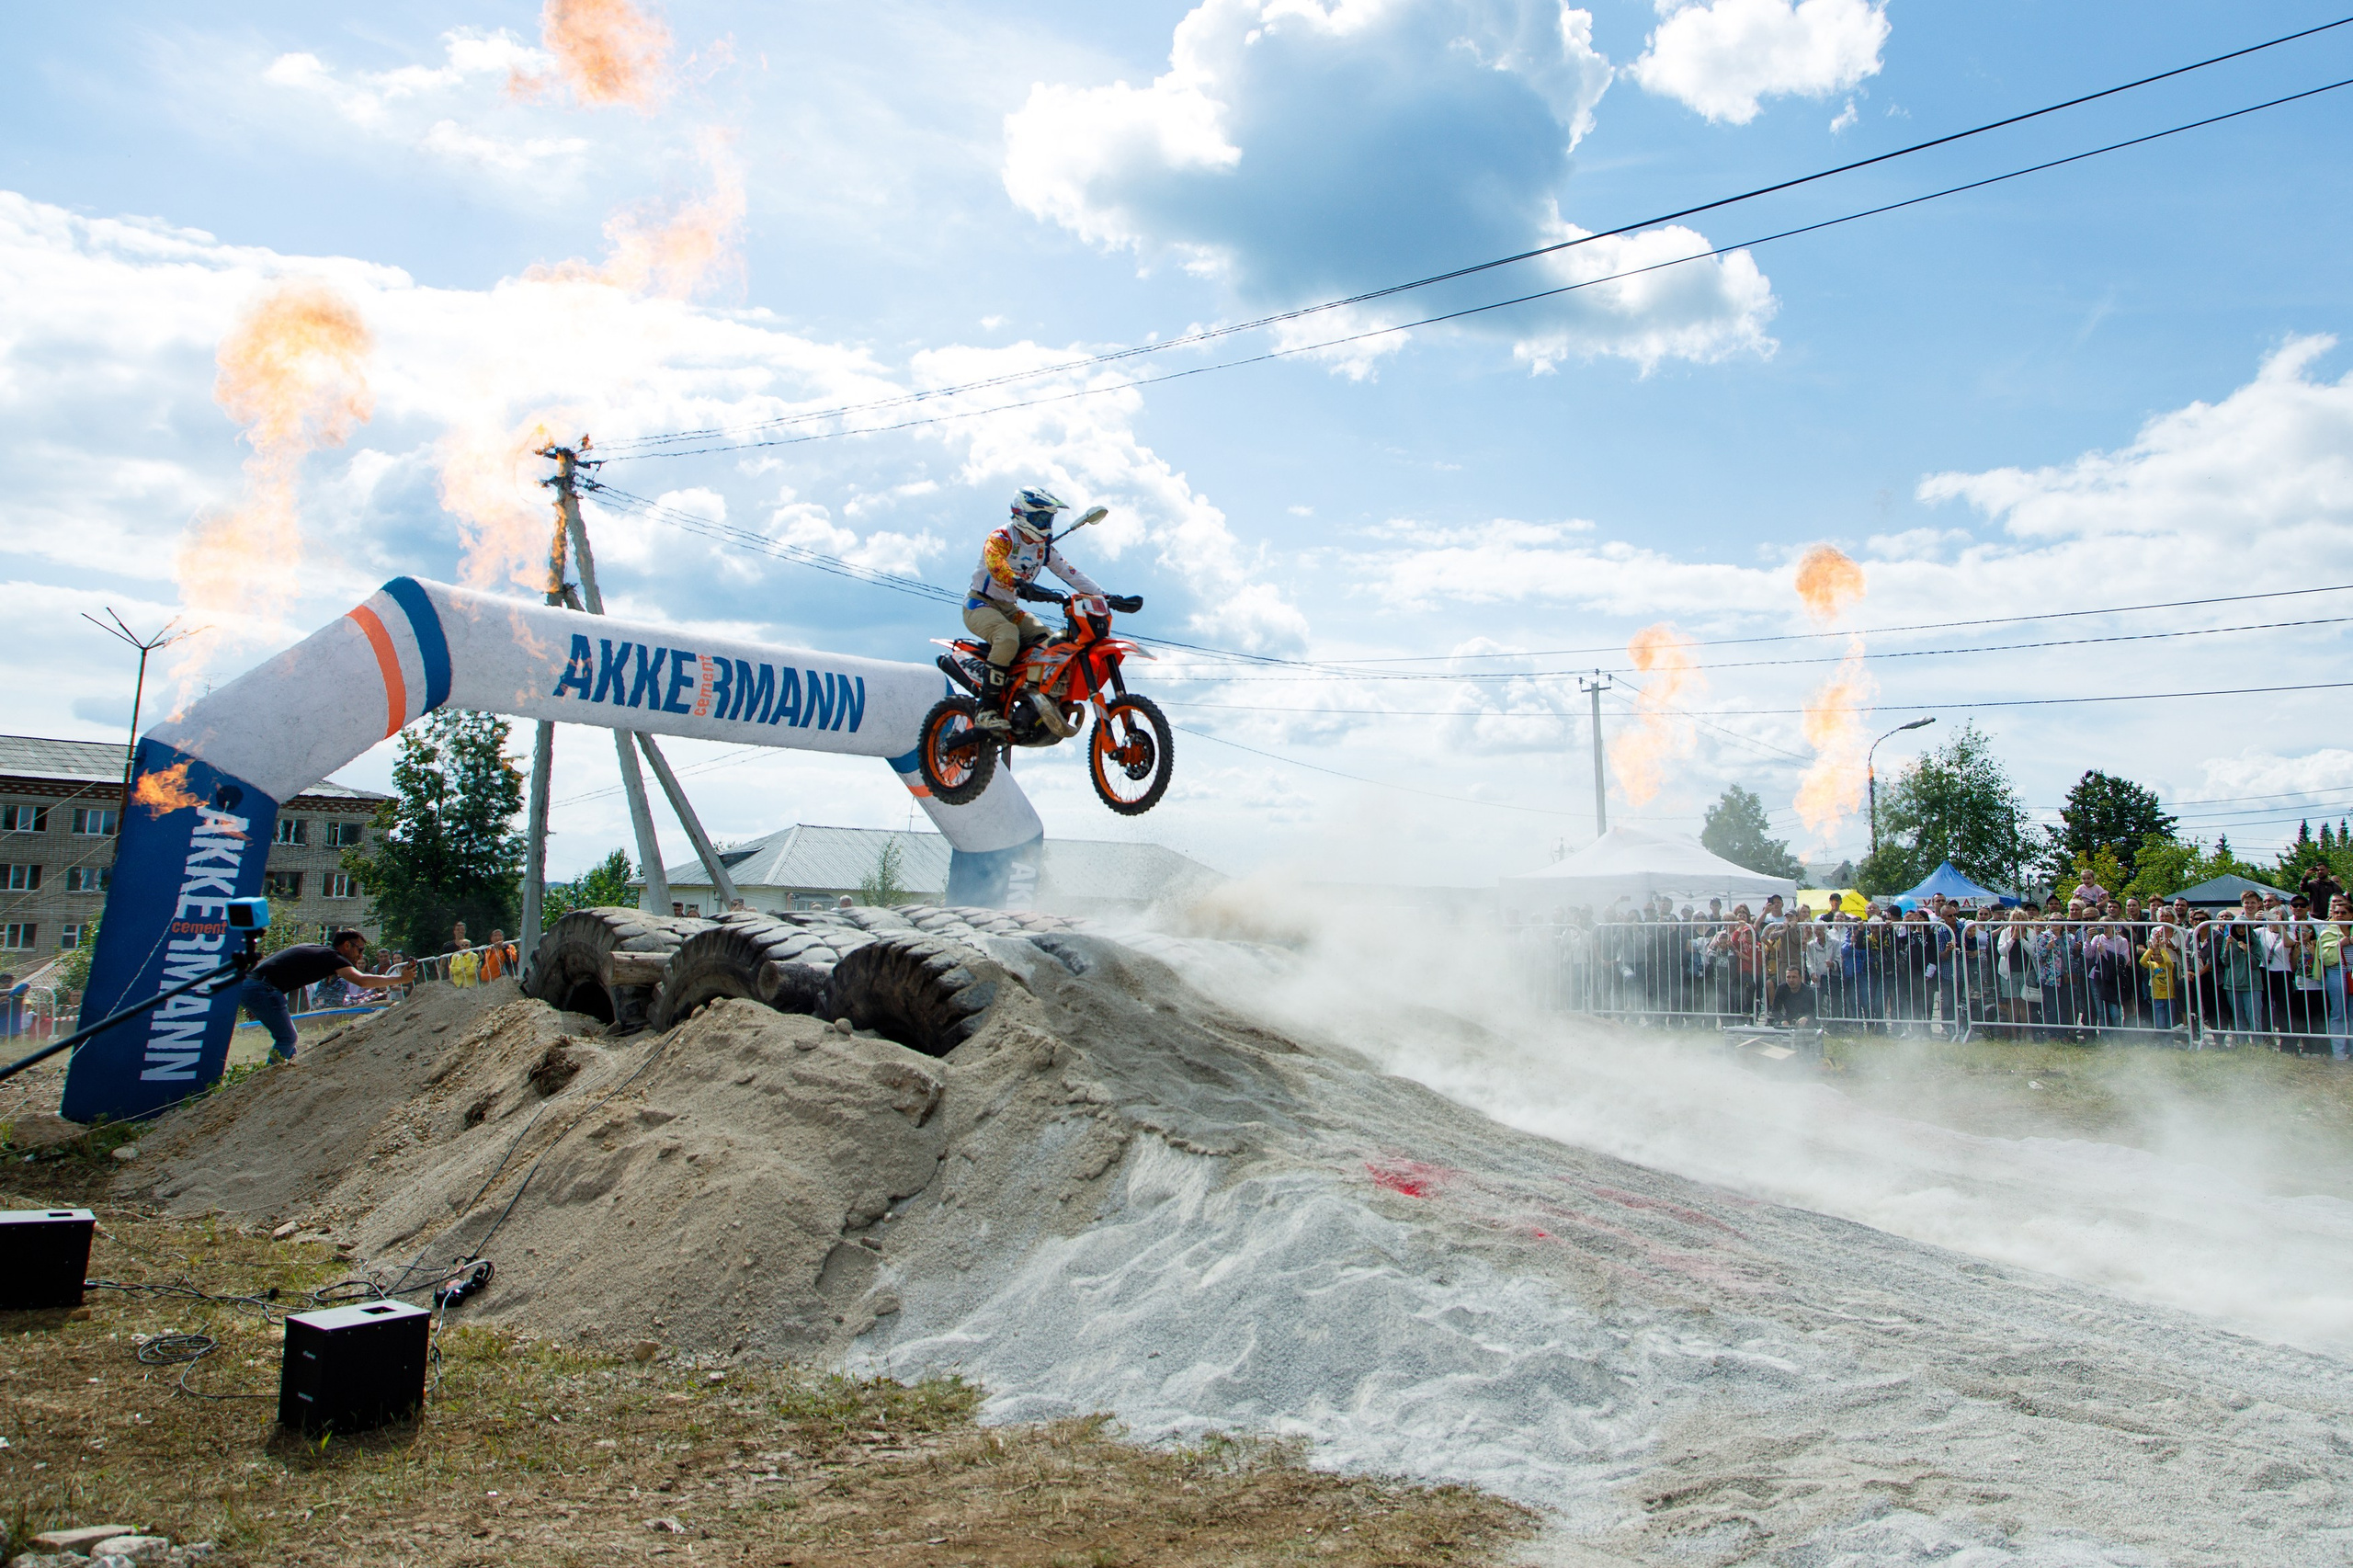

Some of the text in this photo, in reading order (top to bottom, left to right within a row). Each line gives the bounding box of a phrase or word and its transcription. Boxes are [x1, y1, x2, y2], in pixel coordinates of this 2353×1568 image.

[552, 633, 866, 733] AKKERMANN
[694, 654, 714, 716] cement
[140, 805, 251, 1081] AKKERMANN
[172, 921, 227, 934] cement
